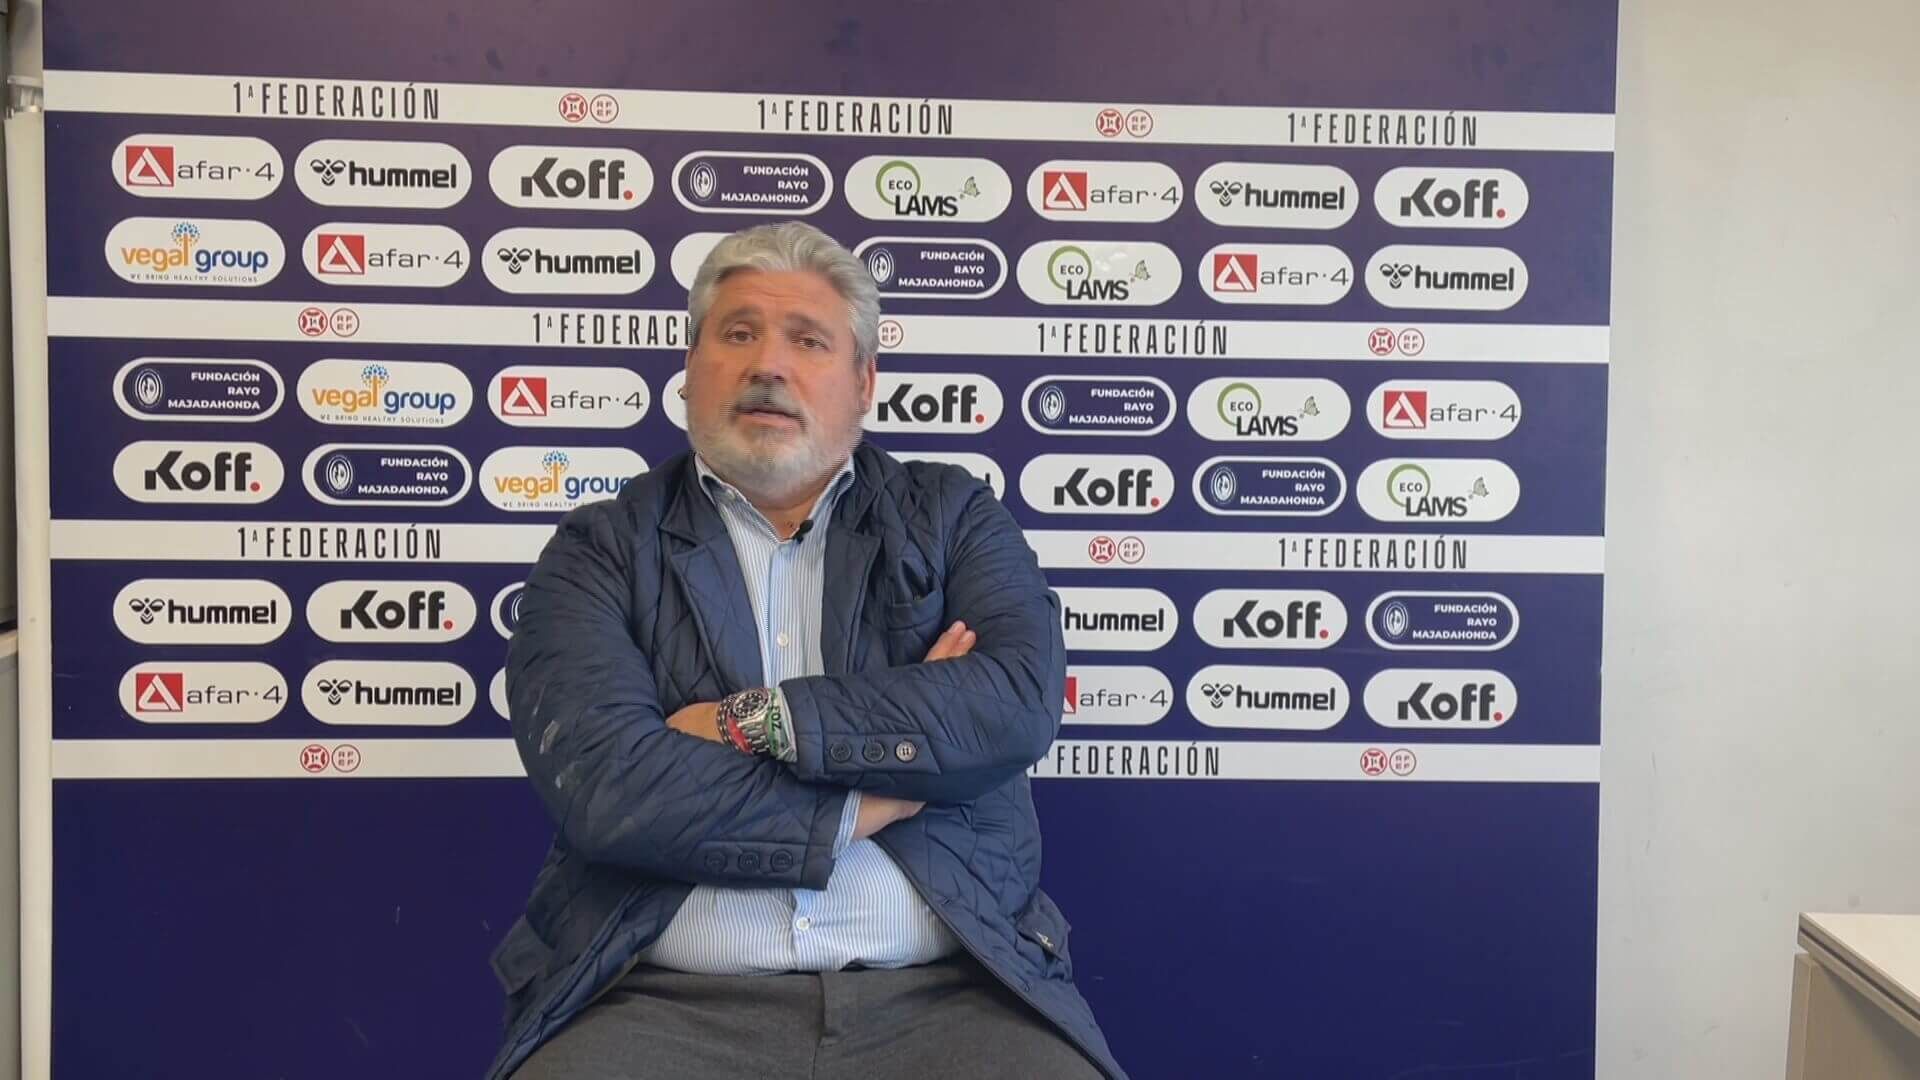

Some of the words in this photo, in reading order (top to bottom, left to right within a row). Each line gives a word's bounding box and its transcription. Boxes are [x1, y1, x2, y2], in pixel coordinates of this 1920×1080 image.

[262, 80, 440, 120] FEDERACIÓN
[785, 97, 953, 135] FEDERACIÓN
[1313, 109, 1477, 147] FEDERACIÓN
[349, 161, 456, 188] hummel
[744, 166, 808, 176] FUNDACIÓN
[778, 181, 808, 189] RAYO
[889, 180, 912, 190] ECO
[722, 193, 808, 203] MAJADAHONDA
[1245, 183, 1345, 210] hummel
[894, 195, 958, 218] LAMS
[921, 251, 984, 260] FUNDACIÓN
[194, 249, 268, 273] group
[535, 249, 640, 274] hummel
[954, 266, 984, 274] RAYO
[1060, 265, 1083, 275] ECO
[899, 278, 984, 287] MAJADAHONDA
[1412, 266, 1514, 291] hummel
[1066, 280, 1129, 301] LAMS
[560, 313, 689, 346] FEDERACI
[1063, 319, 1226, 356] FEDERACIÓN
[191, 371, 259, 381] FUNDACIÓN
[228, 387, 260, 395] RAYO
[1091, 388, 1154, 397] FUNDACIÓN
[168, 400, 260, 409] MAJADAHONDA
[384, 392, 456, 414] group
[1124, 403, 1154, 411] RAYO
[1230, 402, 1253, 411] ECO
[1069, 415, 1153, 424] MAJADAHONDA
[1236, 415, 1299, 436] LAMS
[381, 457, 448, 467] FUNDACIÓN
[417, 472, 448, 481] RAYO
[1262, 468, 1325, 478] FUNDACIÓN
[358, 485, 448, 494] MAJADAHONDA
[1295, 483, 1325, 492] RAYO
[1400, 483, 1422, 492] ECO
[1241, 496, 1324, 505] MAJADAHONDA
[1405, 496, 1468, 518] LAMS
[265, 522, 442, 559] FEDERACIÓN
[1304, 534, 1468, 569] FEDERACIÓN
[168, 599, 276, 624] hummel
[1434, 603, 1497, 613] FUNDACIÓN
[1065, 607, 1164, 631] hummel
[1467, 618, 1497, 626] RAYO
[1413, 630, 1496, 639] MAJADAHONDA
[355, 680, 461, 706] hummel
[1236, 688, 1335, 710] hummel
[1057, 740, 1219, 774] FEDERACIÓN
